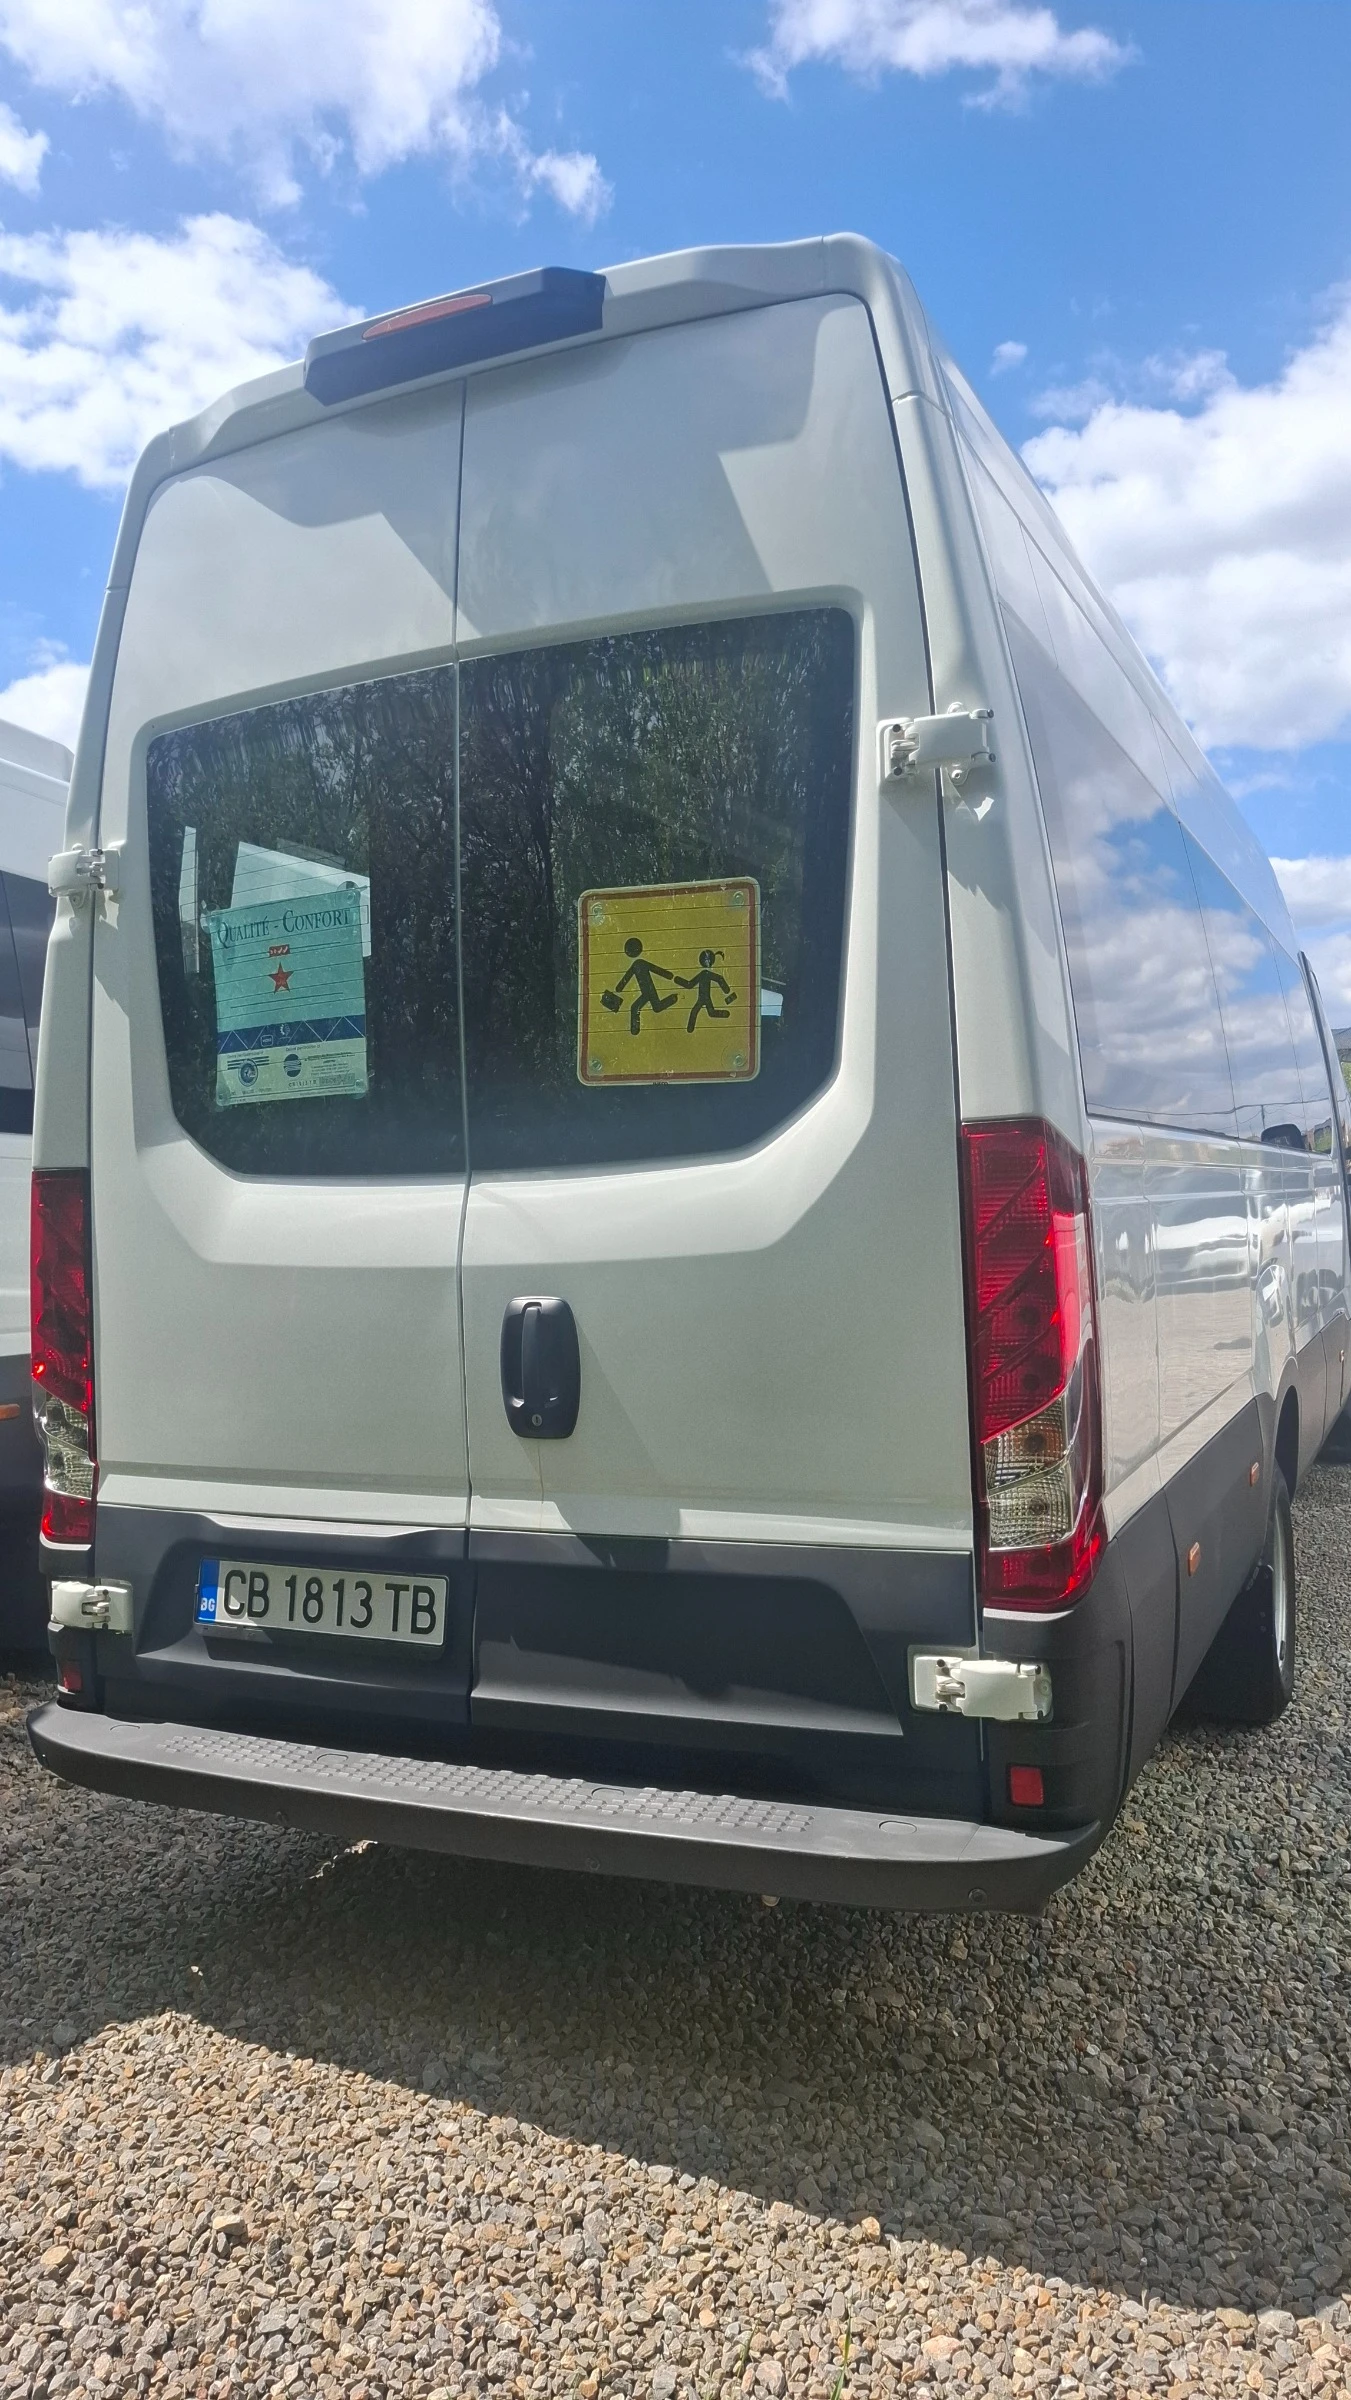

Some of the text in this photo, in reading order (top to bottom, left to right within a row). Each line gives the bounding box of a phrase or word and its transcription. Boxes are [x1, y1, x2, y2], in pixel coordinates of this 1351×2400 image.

[217, 916, 269, 948] QUALITÉ
[282, 909, 350, 932] CONFORT
[200, 1597, 216, 1612] BG
[223, 1569, 436, 1635] CB 1813 TB
